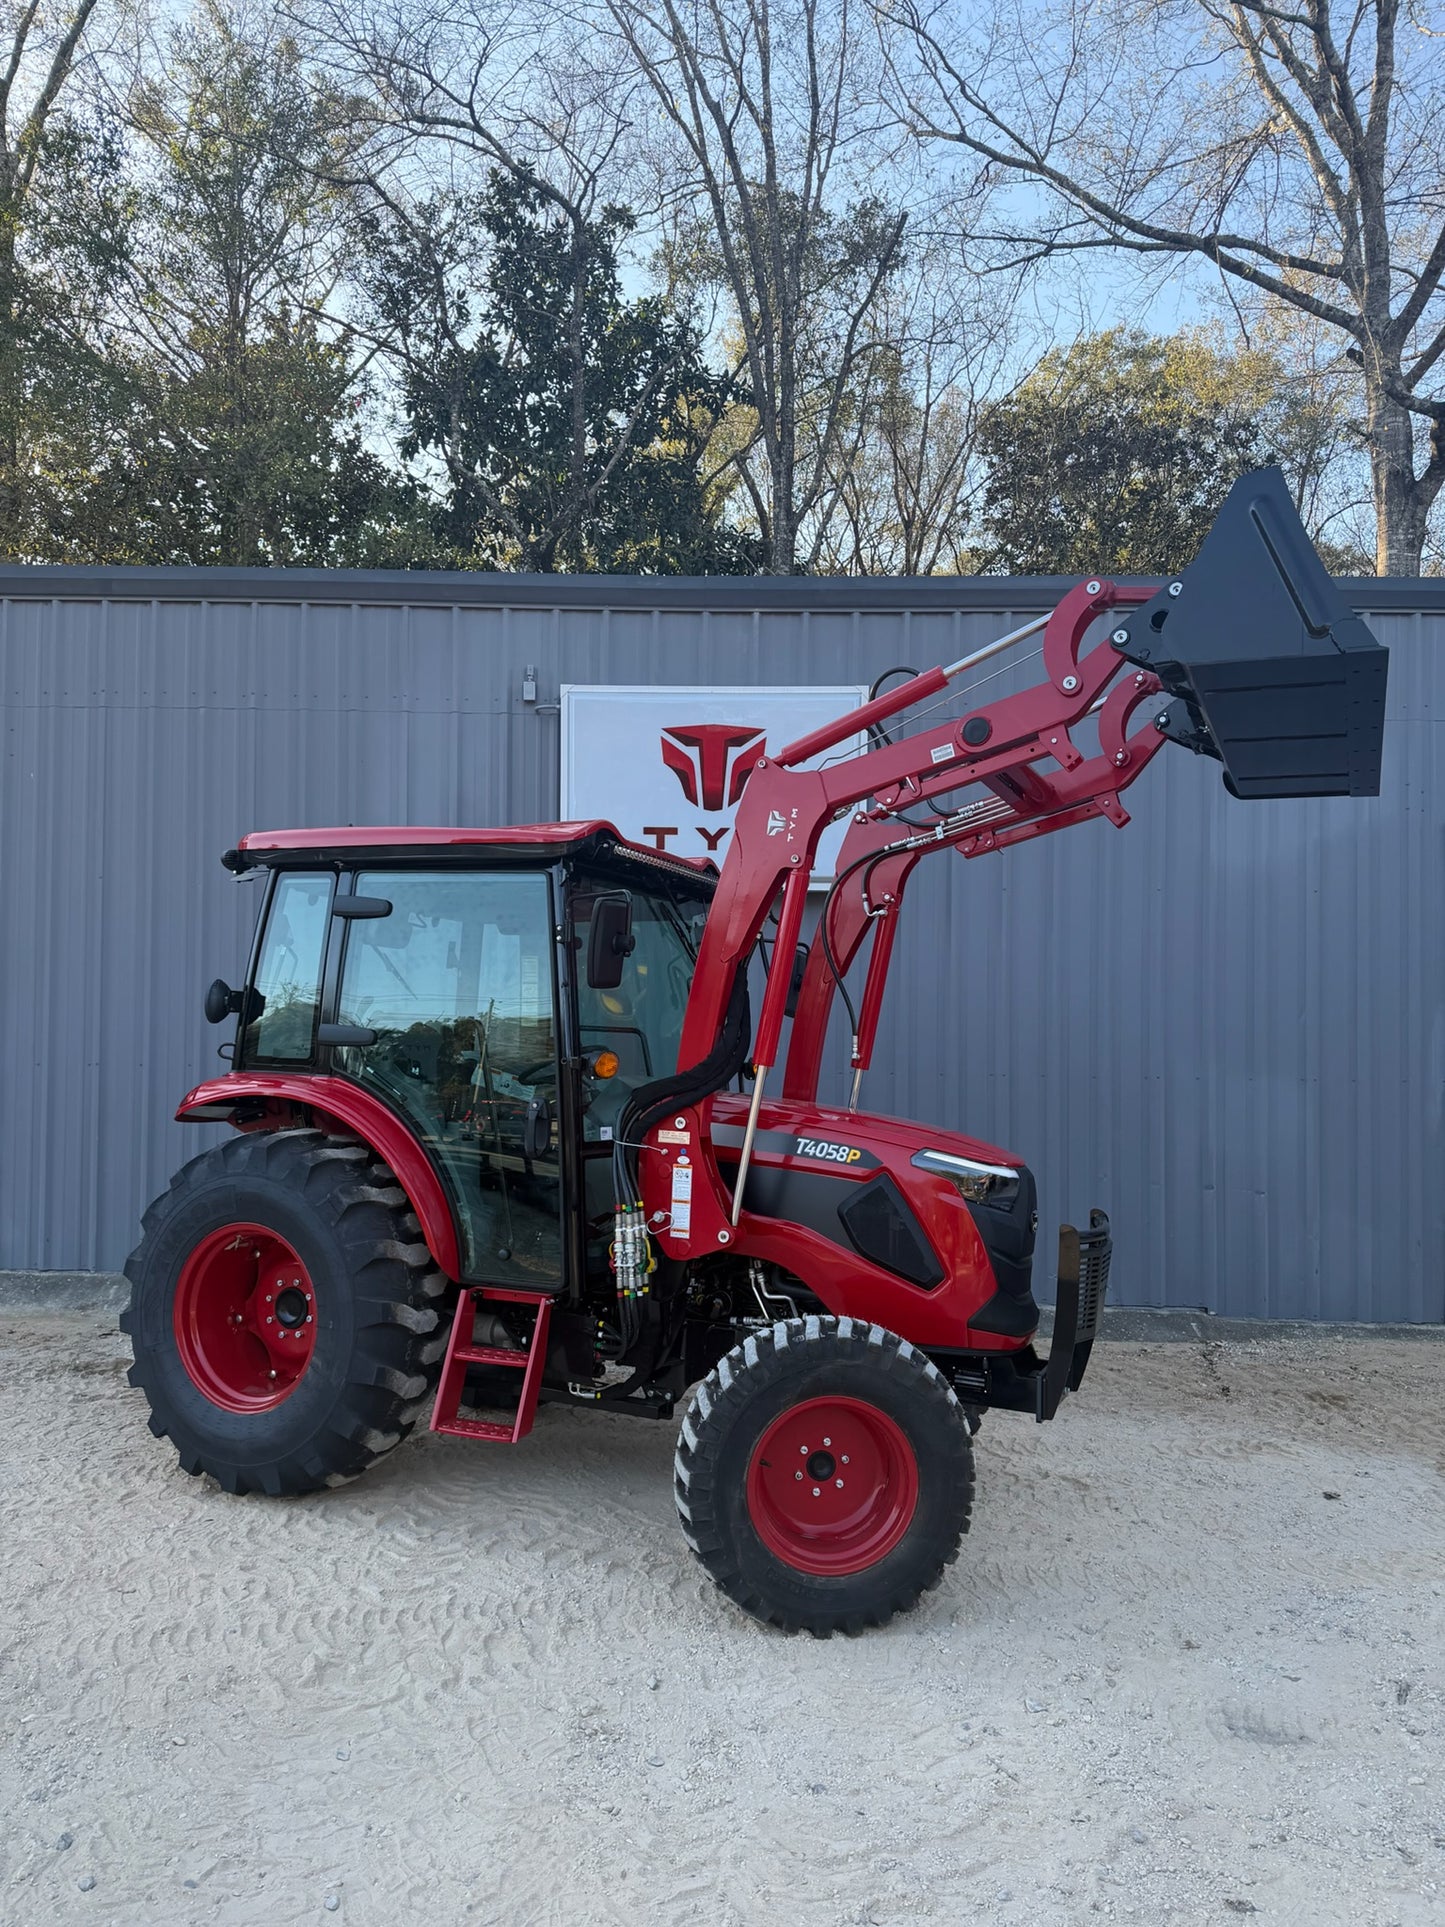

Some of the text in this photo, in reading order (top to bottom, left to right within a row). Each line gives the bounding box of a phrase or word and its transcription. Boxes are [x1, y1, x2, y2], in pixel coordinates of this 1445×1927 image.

[787, 808, 798, 842] TYM
[643, 827, 730, 850] TY
[796, 1138, 861, 1163] T4058P
